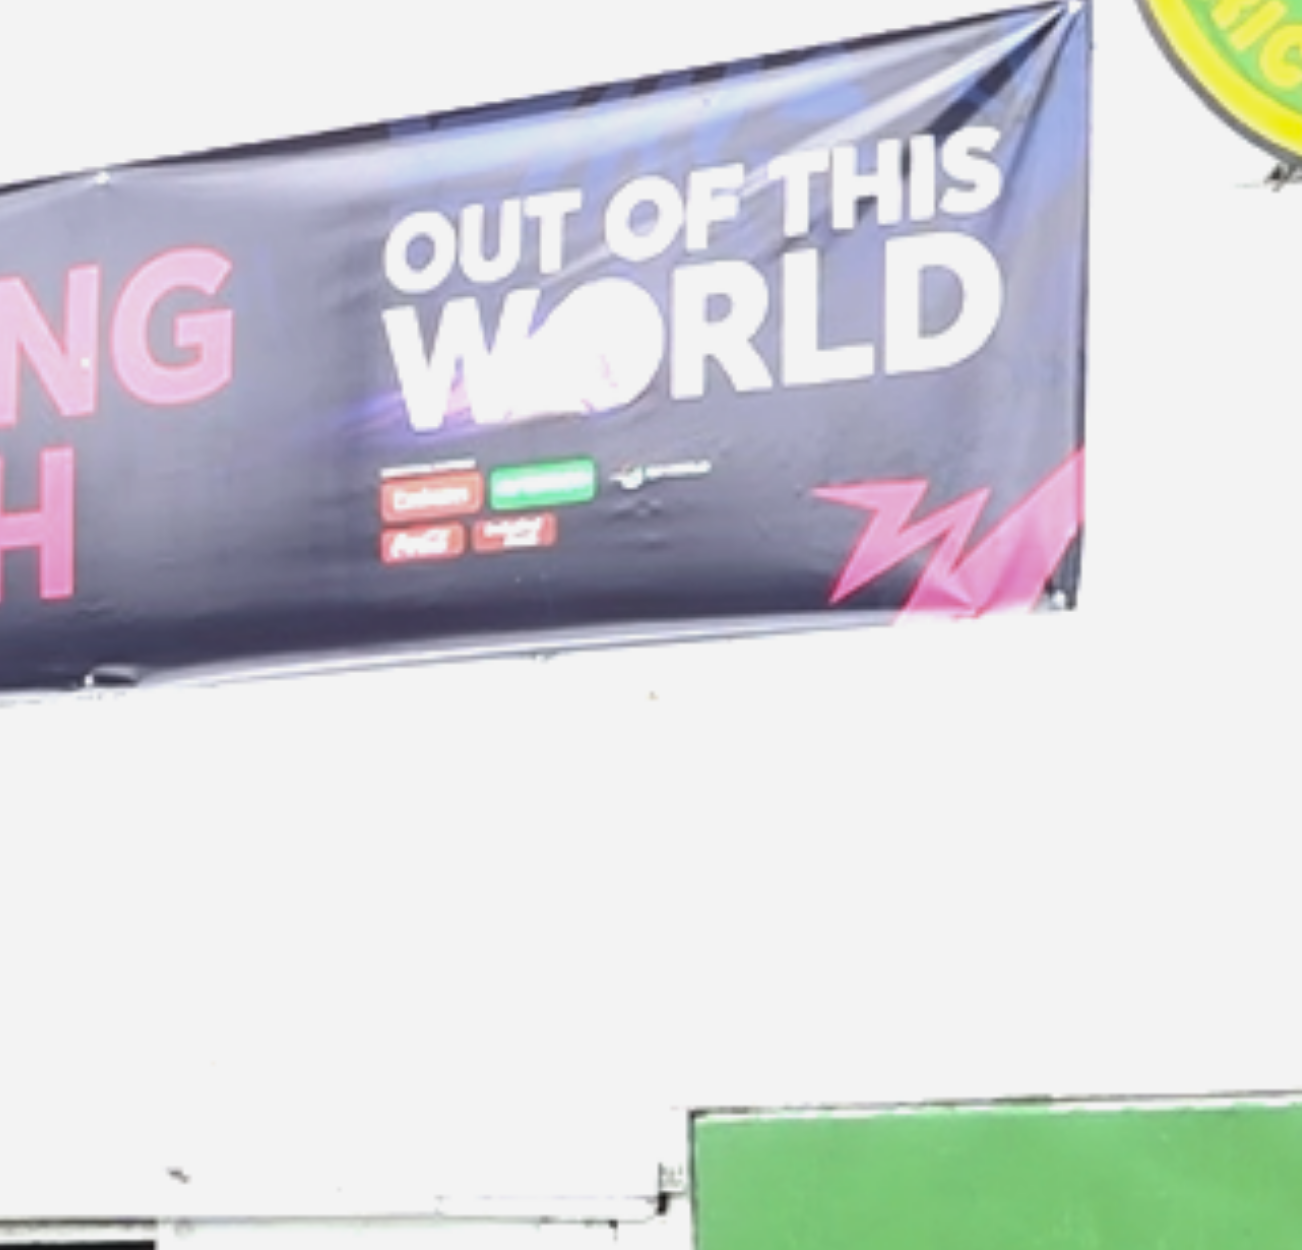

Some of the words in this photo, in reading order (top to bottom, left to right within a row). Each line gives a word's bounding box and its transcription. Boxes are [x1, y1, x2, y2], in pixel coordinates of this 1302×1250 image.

[382, 190, 582, 294] OUT
[603, 162, 746, 262] OF
[765, 126, 1002, 238] THIS
[381, 231, 1005, 433] WORLD
